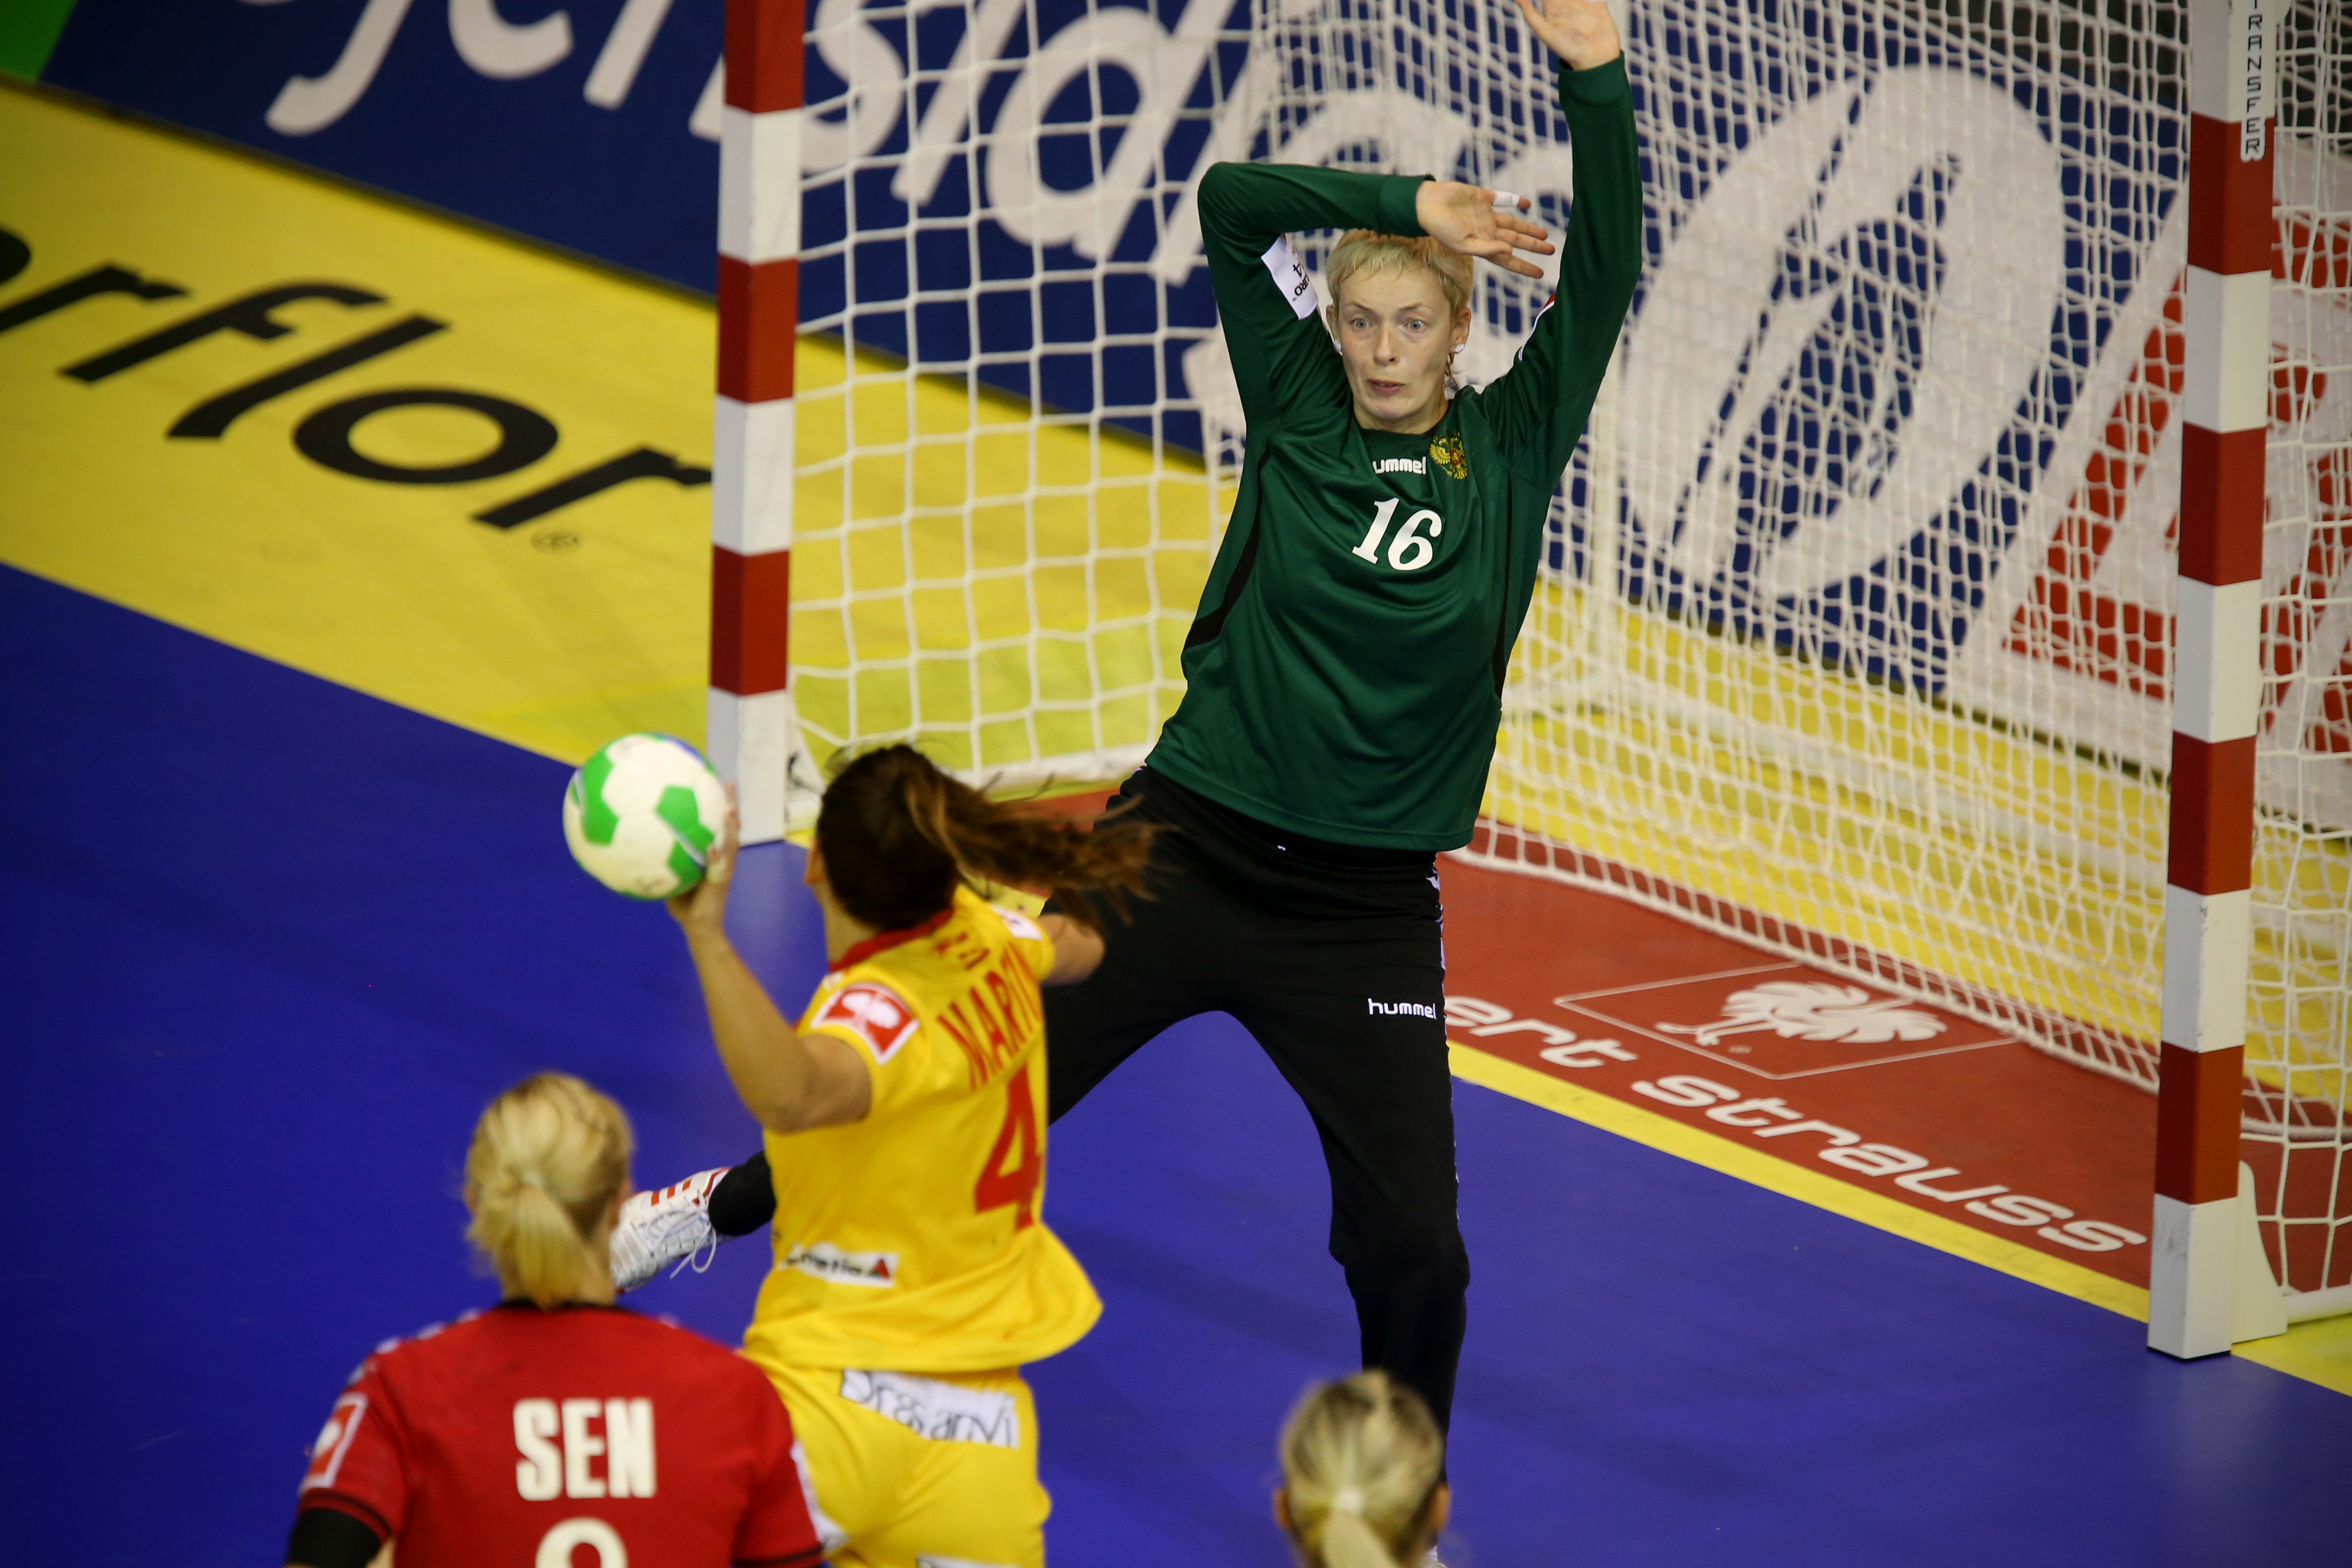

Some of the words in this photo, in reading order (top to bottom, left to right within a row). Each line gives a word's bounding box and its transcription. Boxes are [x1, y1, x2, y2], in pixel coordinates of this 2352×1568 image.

[1294, 271, 1309, 296] URO
[0, 223, 713, 533] rflor
[1372, 456, 1427, 475] ummel
[1352, 497, 1443, 571] 16
[1367, 998, 1437, 1019] hummel
[974, 1061, 1042, 1231] 4
[1444, 995, 1639, 1068] ert
[1631, 1075, 2148, 1252] strauss
[512, 1396, 657, 1502] SEN
